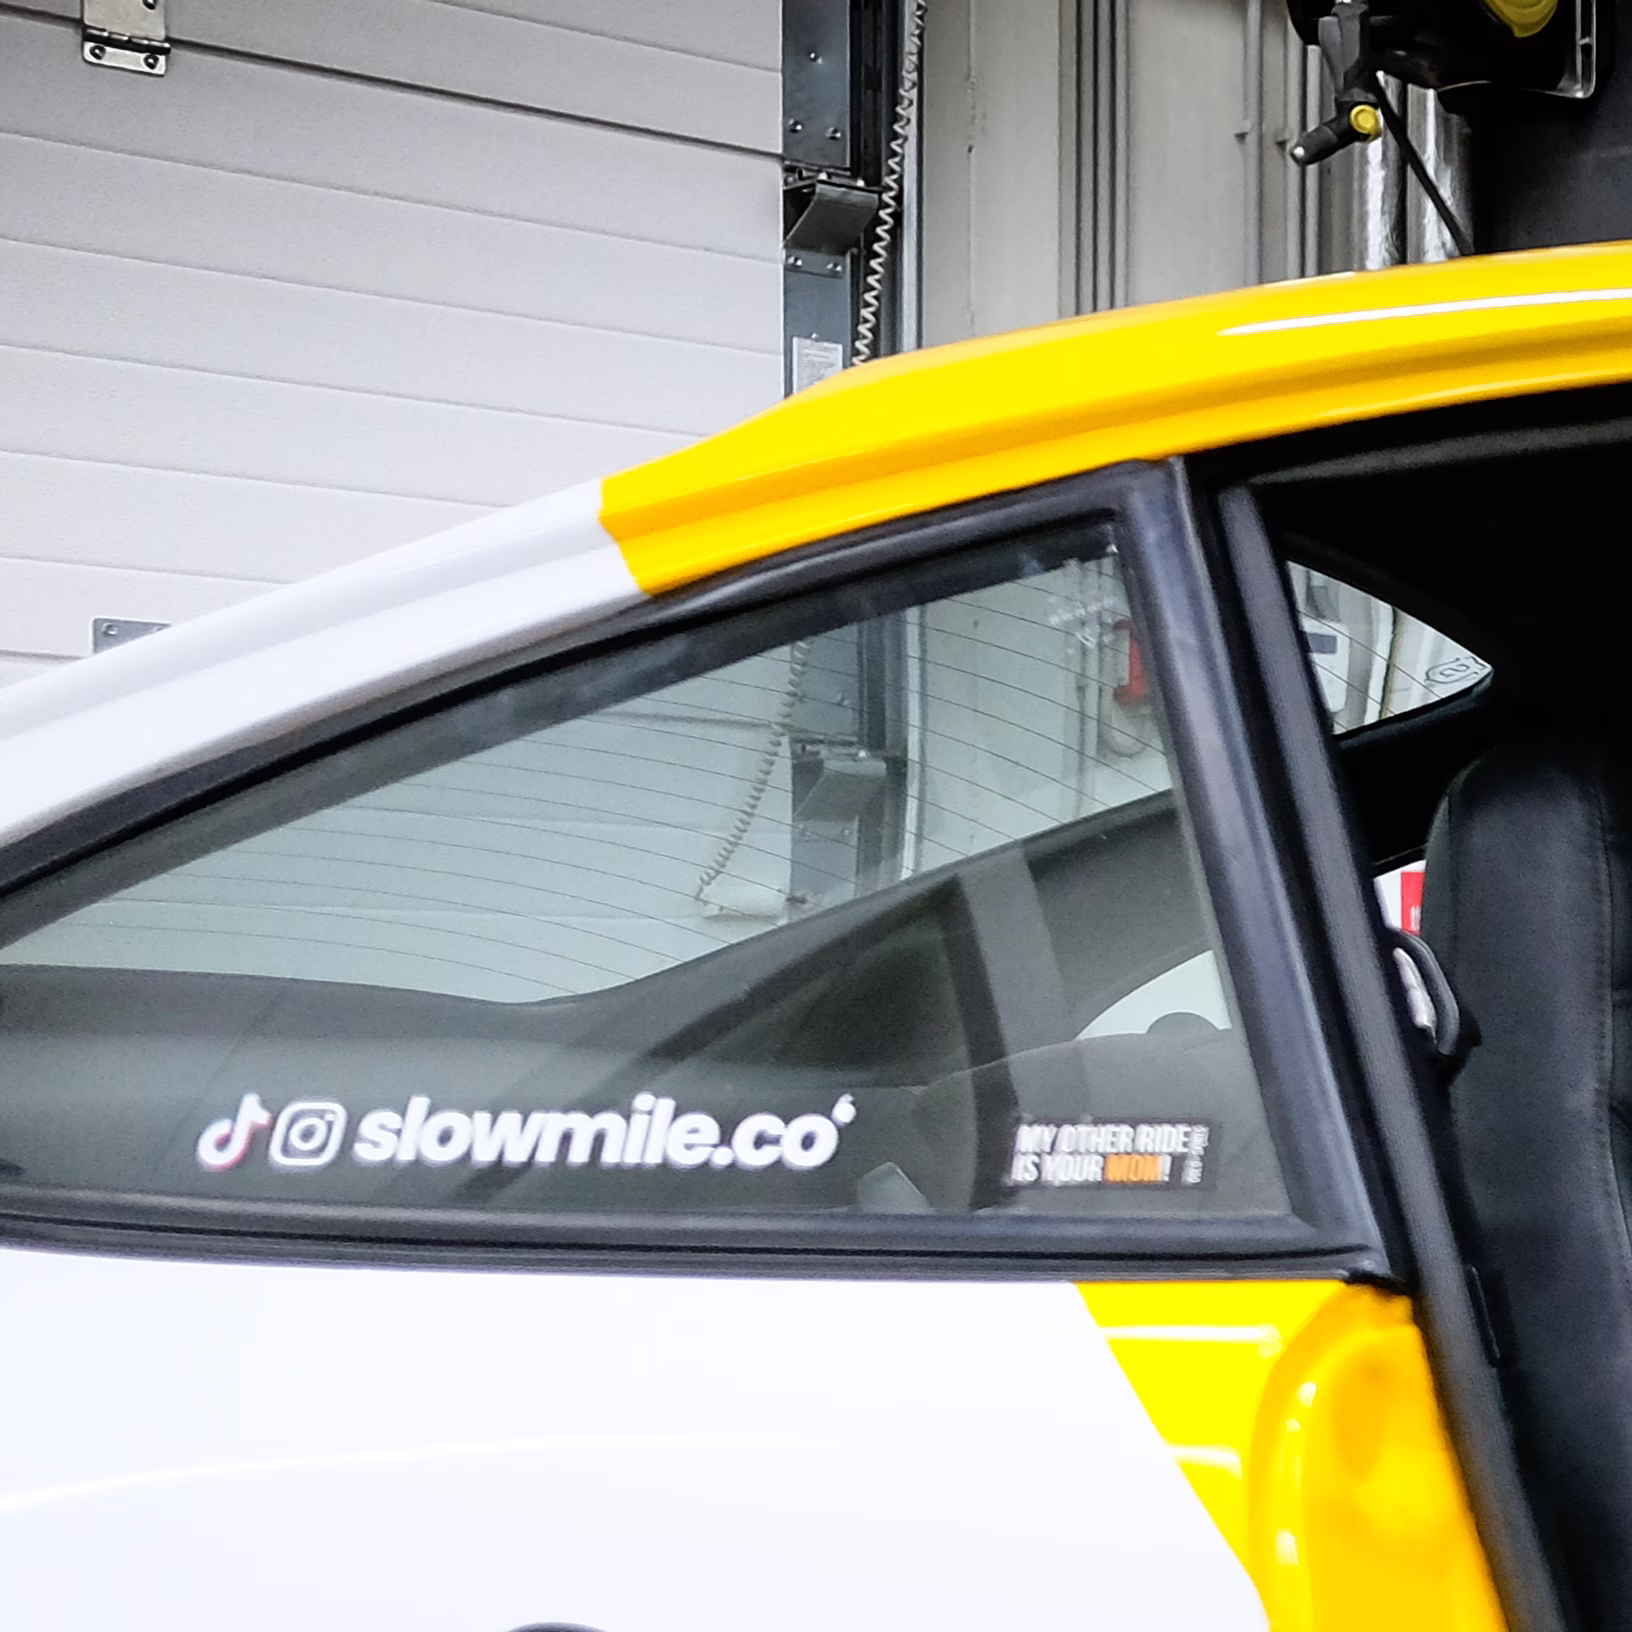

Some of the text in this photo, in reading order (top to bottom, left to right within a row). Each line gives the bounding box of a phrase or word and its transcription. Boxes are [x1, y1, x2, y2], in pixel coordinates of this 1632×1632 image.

[1015, 1123, 1190, 1153] MY OTHER RIDE
[1011, 1153, 1040, 1182] IS
[1041, 1153, 1104, 1183] YOUR
